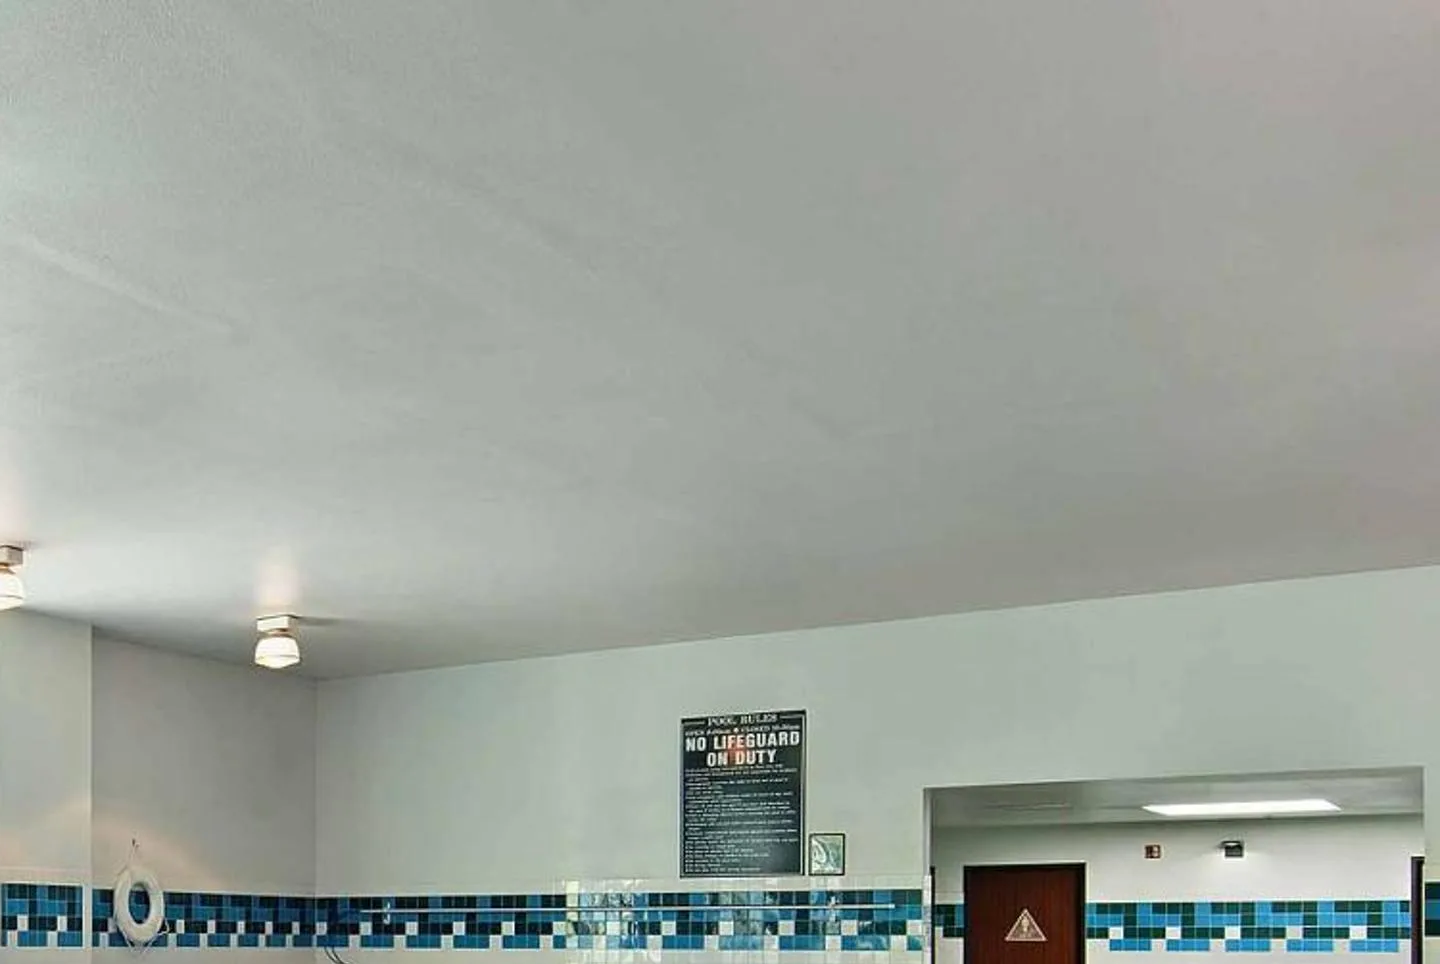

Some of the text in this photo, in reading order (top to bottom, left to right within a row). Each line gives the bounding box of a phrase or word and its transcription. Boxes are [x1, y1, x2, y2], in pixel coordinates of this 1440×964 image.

[740, 713, 777, 725] RULES
[685, 731, 800, 752] NO LIFEGUARD
[706, 748, 777, 767] ON DUTY
